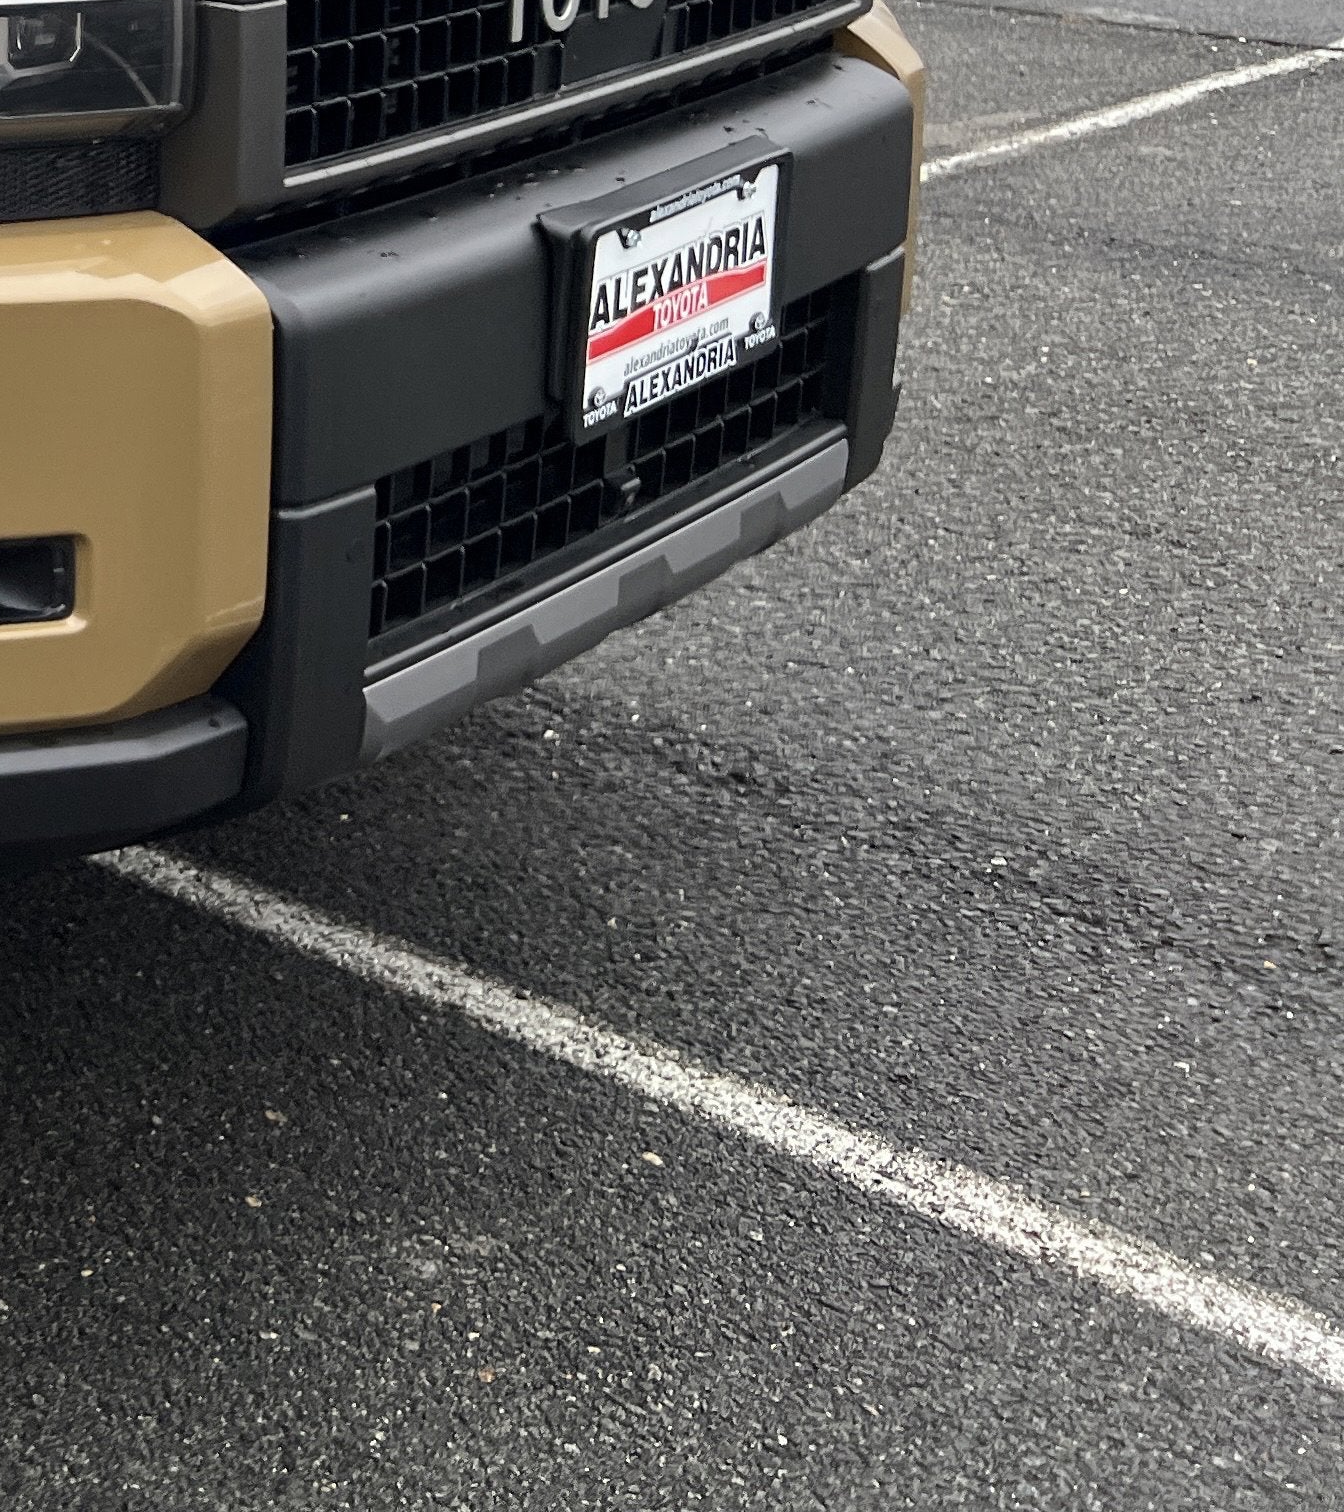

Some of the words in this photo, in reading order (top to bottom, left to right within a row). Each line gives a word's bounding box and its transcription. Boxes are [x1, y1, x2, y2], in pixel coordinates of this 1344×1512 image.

[590, 216, 766, 330] ALEXANDRIA
[653, 285, 709, 330] TOYOTA
[744, 326, 776, 350] TOYOTA
[626, 340, 735, 414] ALEXANDRIA
[583, 400, 617, 428] TOYOTA
